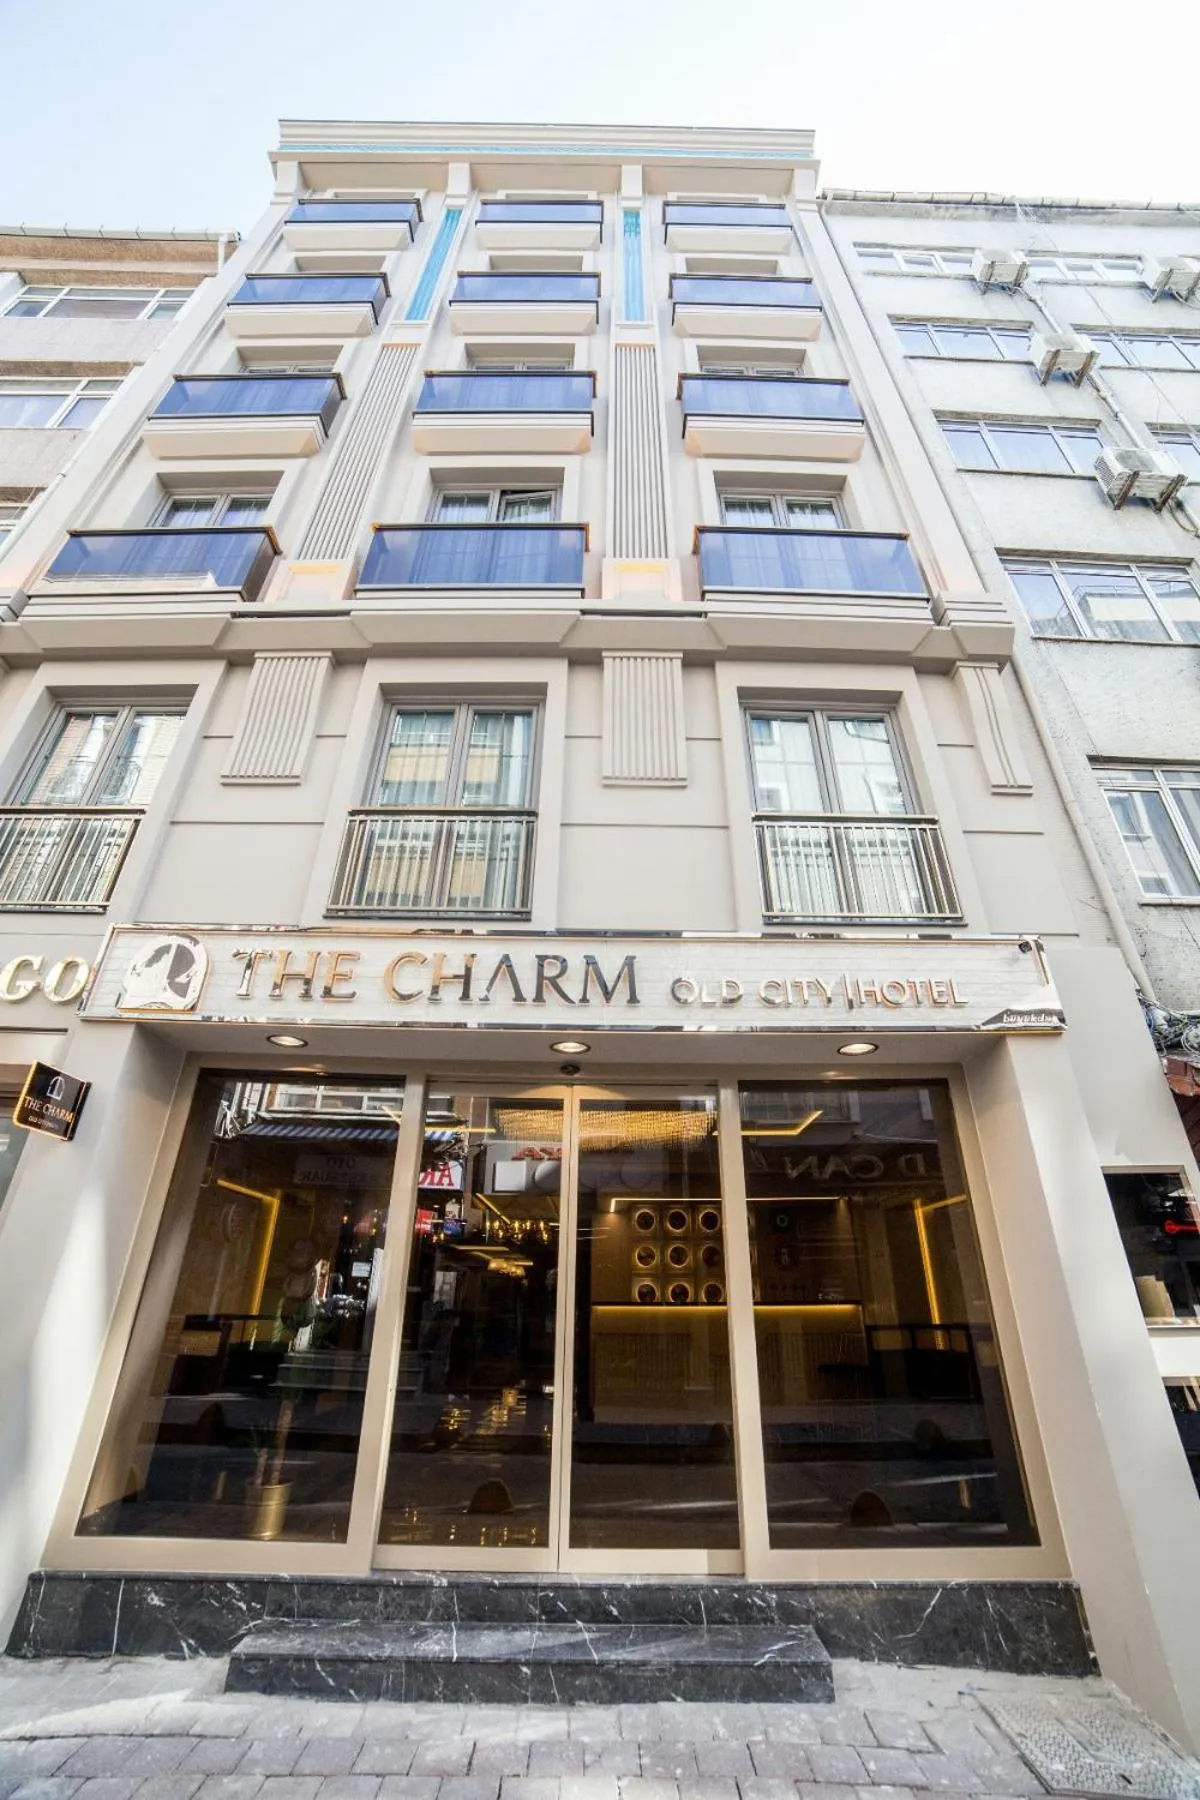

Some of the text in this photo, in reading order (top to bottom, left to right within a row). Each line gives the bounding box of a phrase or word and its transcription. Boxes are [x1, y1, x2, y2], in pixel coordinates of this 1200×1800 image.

[232, 949, 640, 1005] THE CHARM
[671, 976, 744, 1006] OLD
[856, 977, 969, 1008] HOTEL
[24, 1095, 74, 1123] THE CHARM
